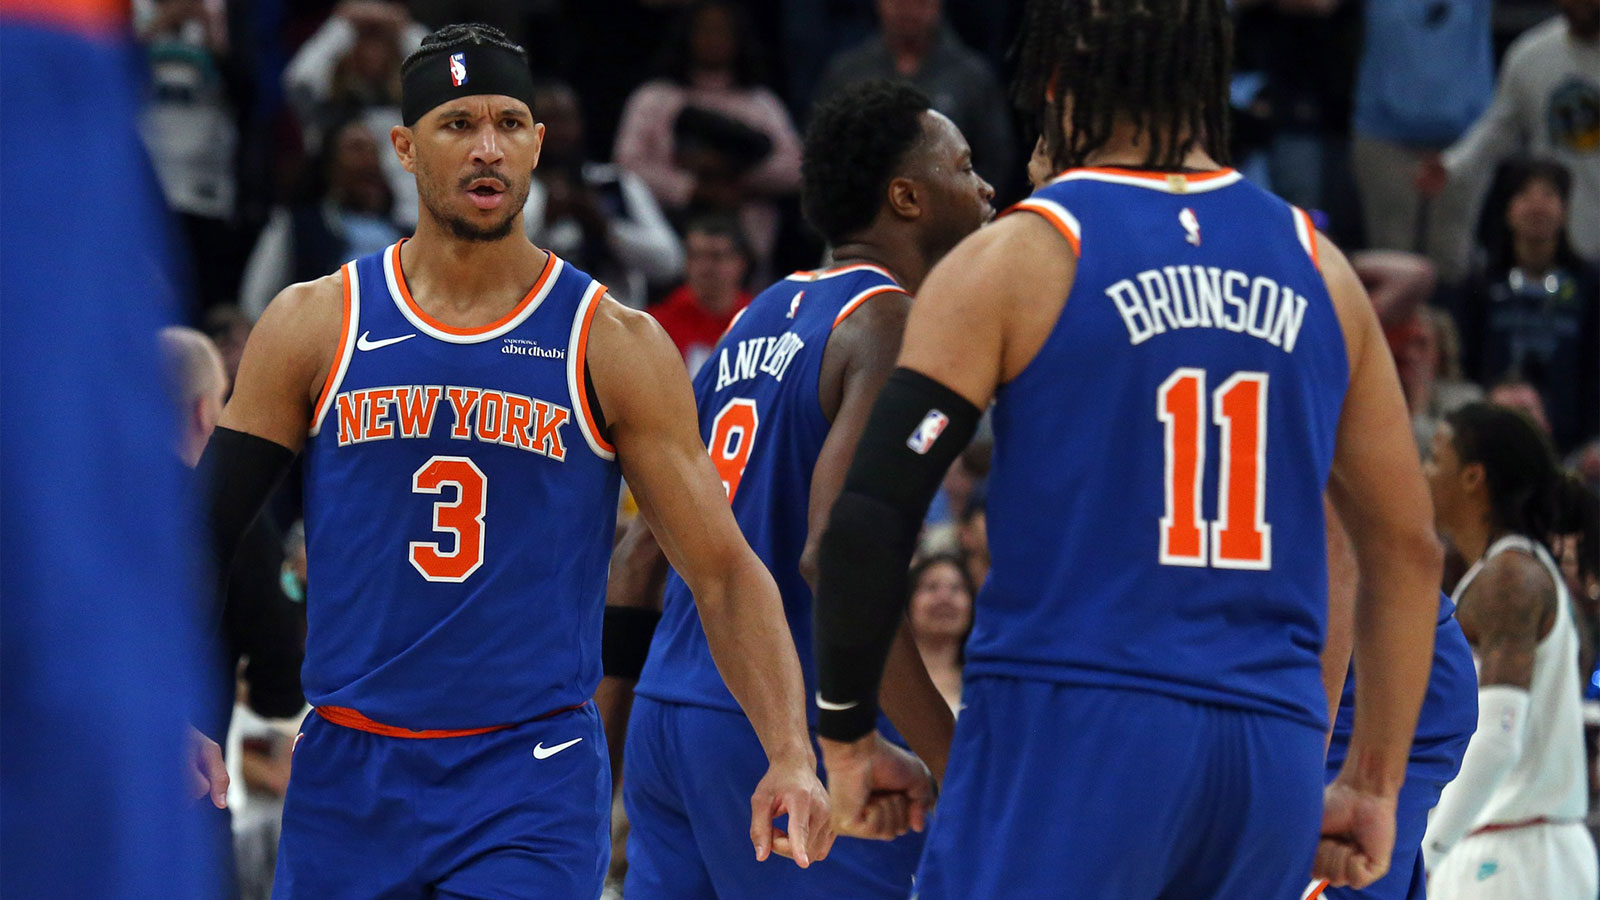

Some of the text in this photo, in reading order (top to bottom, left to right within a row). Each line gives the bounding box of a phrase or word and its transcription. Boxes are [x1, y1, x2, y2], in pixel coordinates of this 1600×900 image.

[501, 344, 565, 359] abu dhabi
[1105, 265, 1308, 353] BRUNSON
[335, 385, 571, 462] NEW YORK
[1156, 367, 1271, 570] 11
[409, 455, 488, 583] 3
